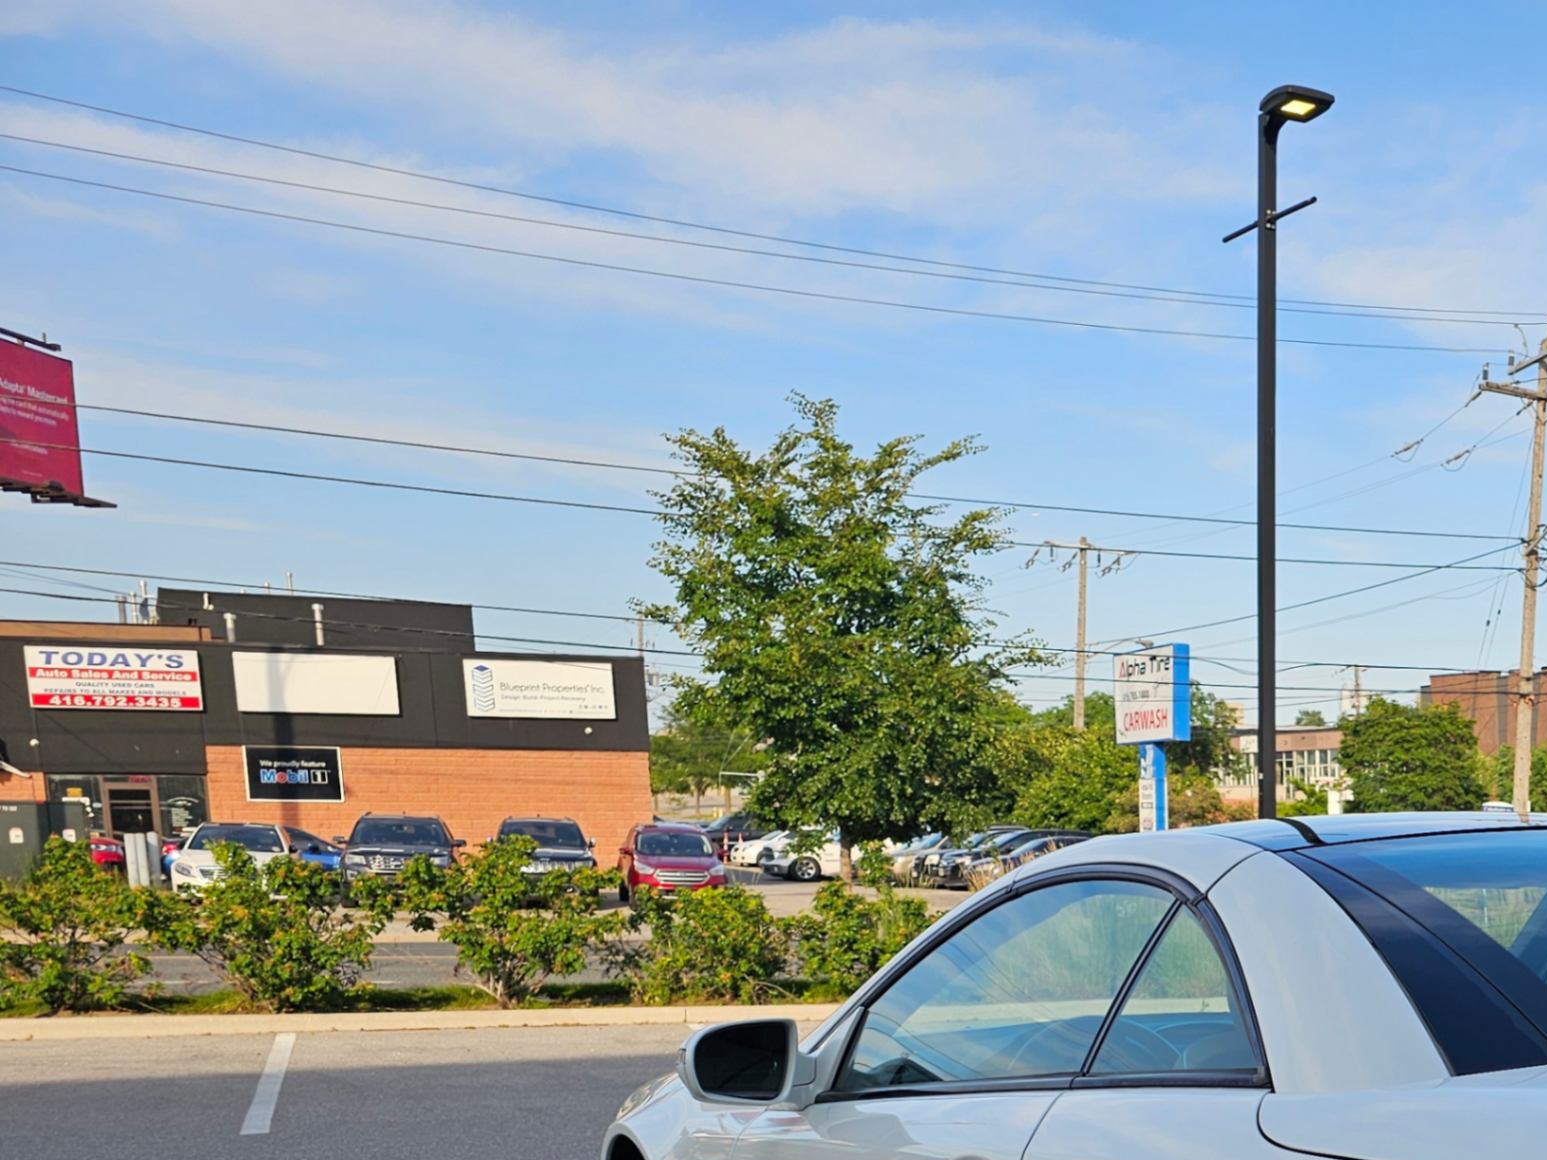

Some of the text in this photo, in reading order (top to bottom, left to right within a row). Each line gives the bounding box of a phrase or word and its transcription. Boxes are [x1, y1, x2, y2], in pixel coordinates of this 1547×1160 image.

[38, 650, 184, 669] TODAY'S
[35, 669, 192, 681] Auto Sales And Service
[499, 682, 606, 694] Blueprint Properties Inc.
[49, 695, 182, 708] 416.792.3435
[1123, 708, 1168, 731] CARWASH
[273, 760, 300, 768] proudly
[260, 769, 309, 784] Mobil
